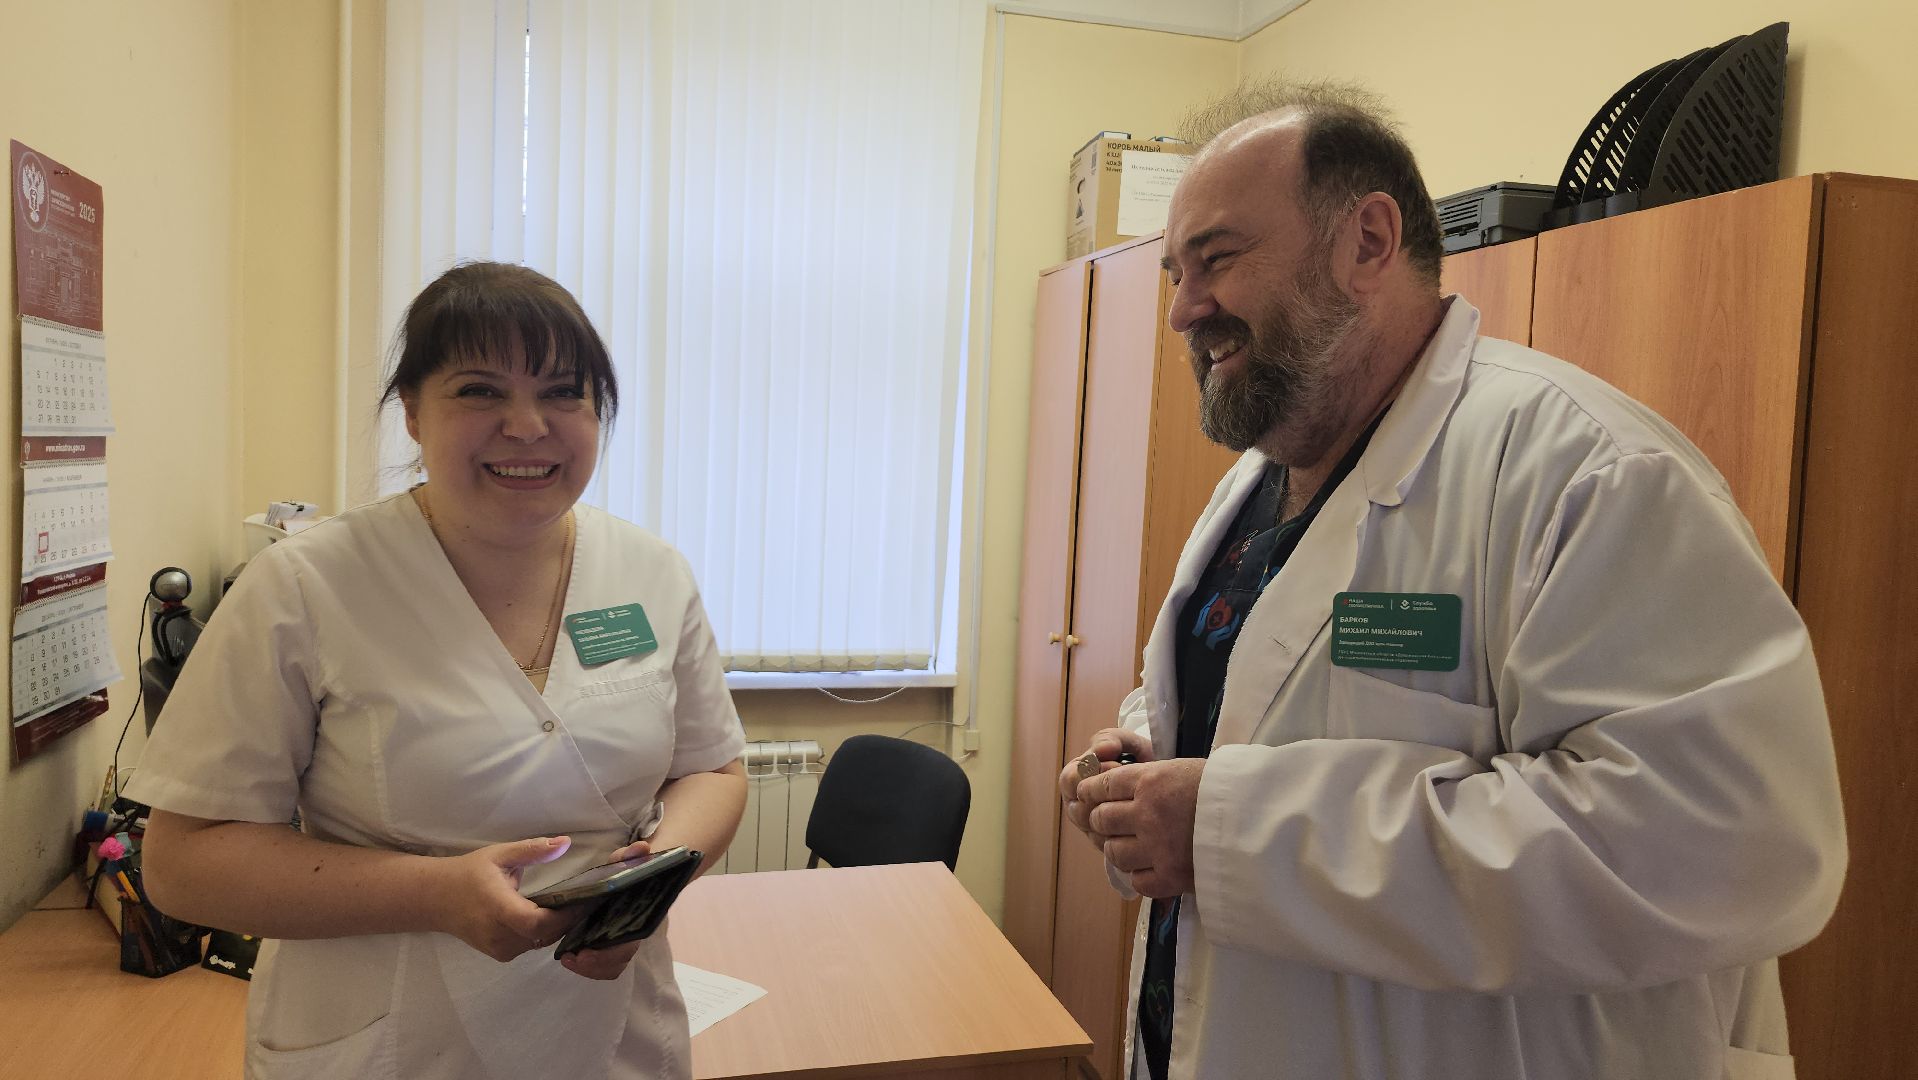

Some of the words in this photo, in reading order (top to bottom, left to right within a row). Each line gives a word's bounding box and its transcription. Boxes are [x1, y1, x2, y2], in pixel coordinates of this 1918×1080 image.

[1107, 142, 1132, 150] КОРОБ
[1132, 144, 1161, 152] МАЛЫЙ
[79, 202, 96, 224] 2025
[1371, 627, 1423, 636] МИХАЙЛОВИЧ
